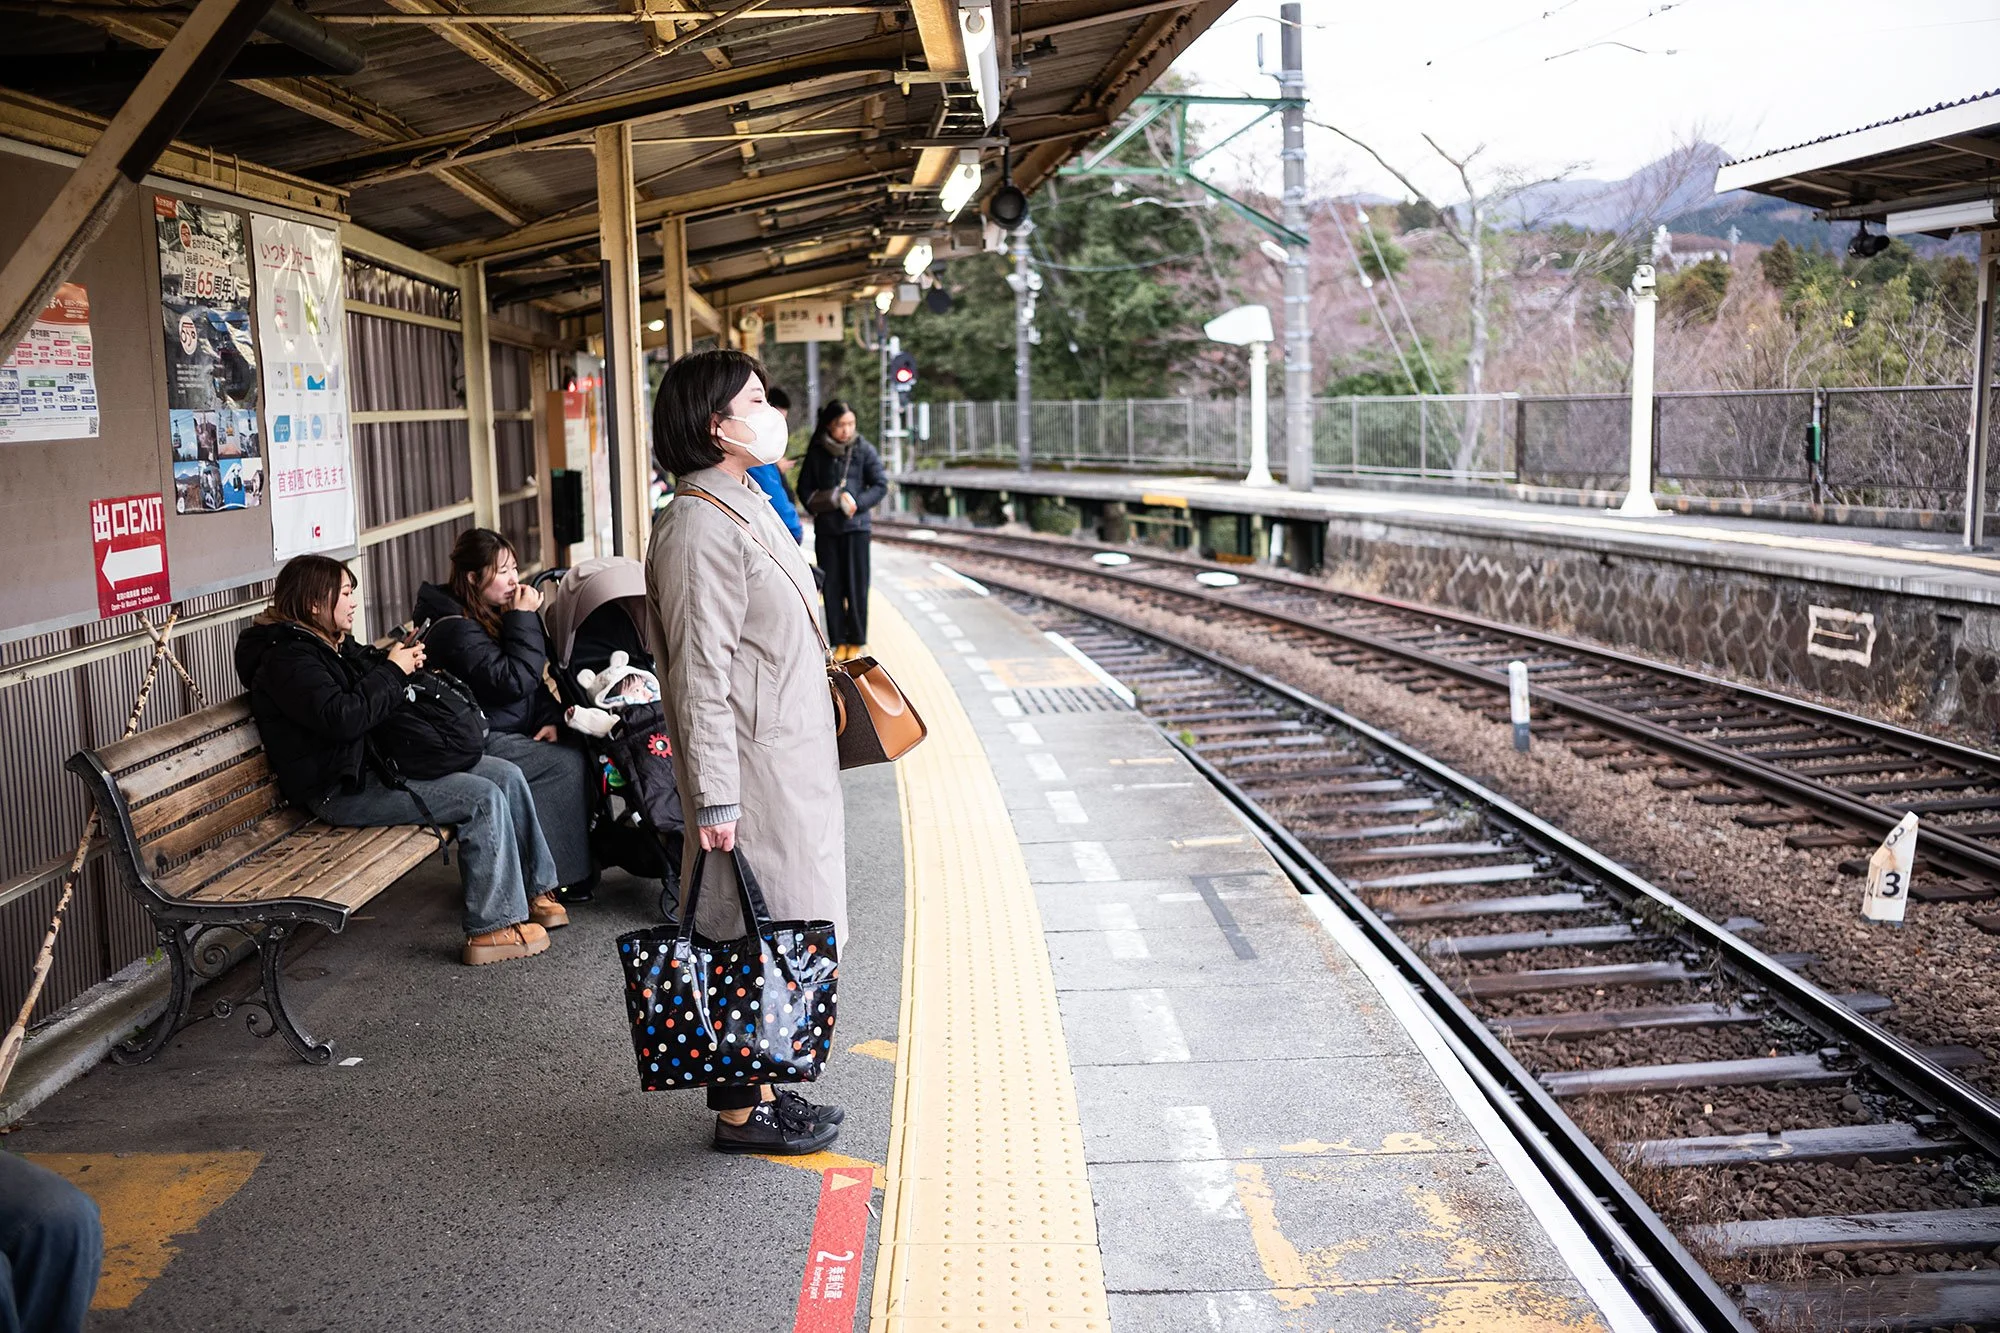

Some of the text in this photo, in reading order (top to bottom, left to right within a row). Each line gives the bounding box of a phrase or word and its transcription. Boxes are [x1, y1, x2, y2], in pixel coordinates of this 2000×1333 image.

[92, 502, 129, 543] 出口
[128, 496, 162, 534] EXIT
[1886, 827, 1904, 846] 3
[1882, 872, 1901, 897] 3
[816, 1251, 855, 1263] 2
[824, 1266, 846, 1299] 乗車位置
